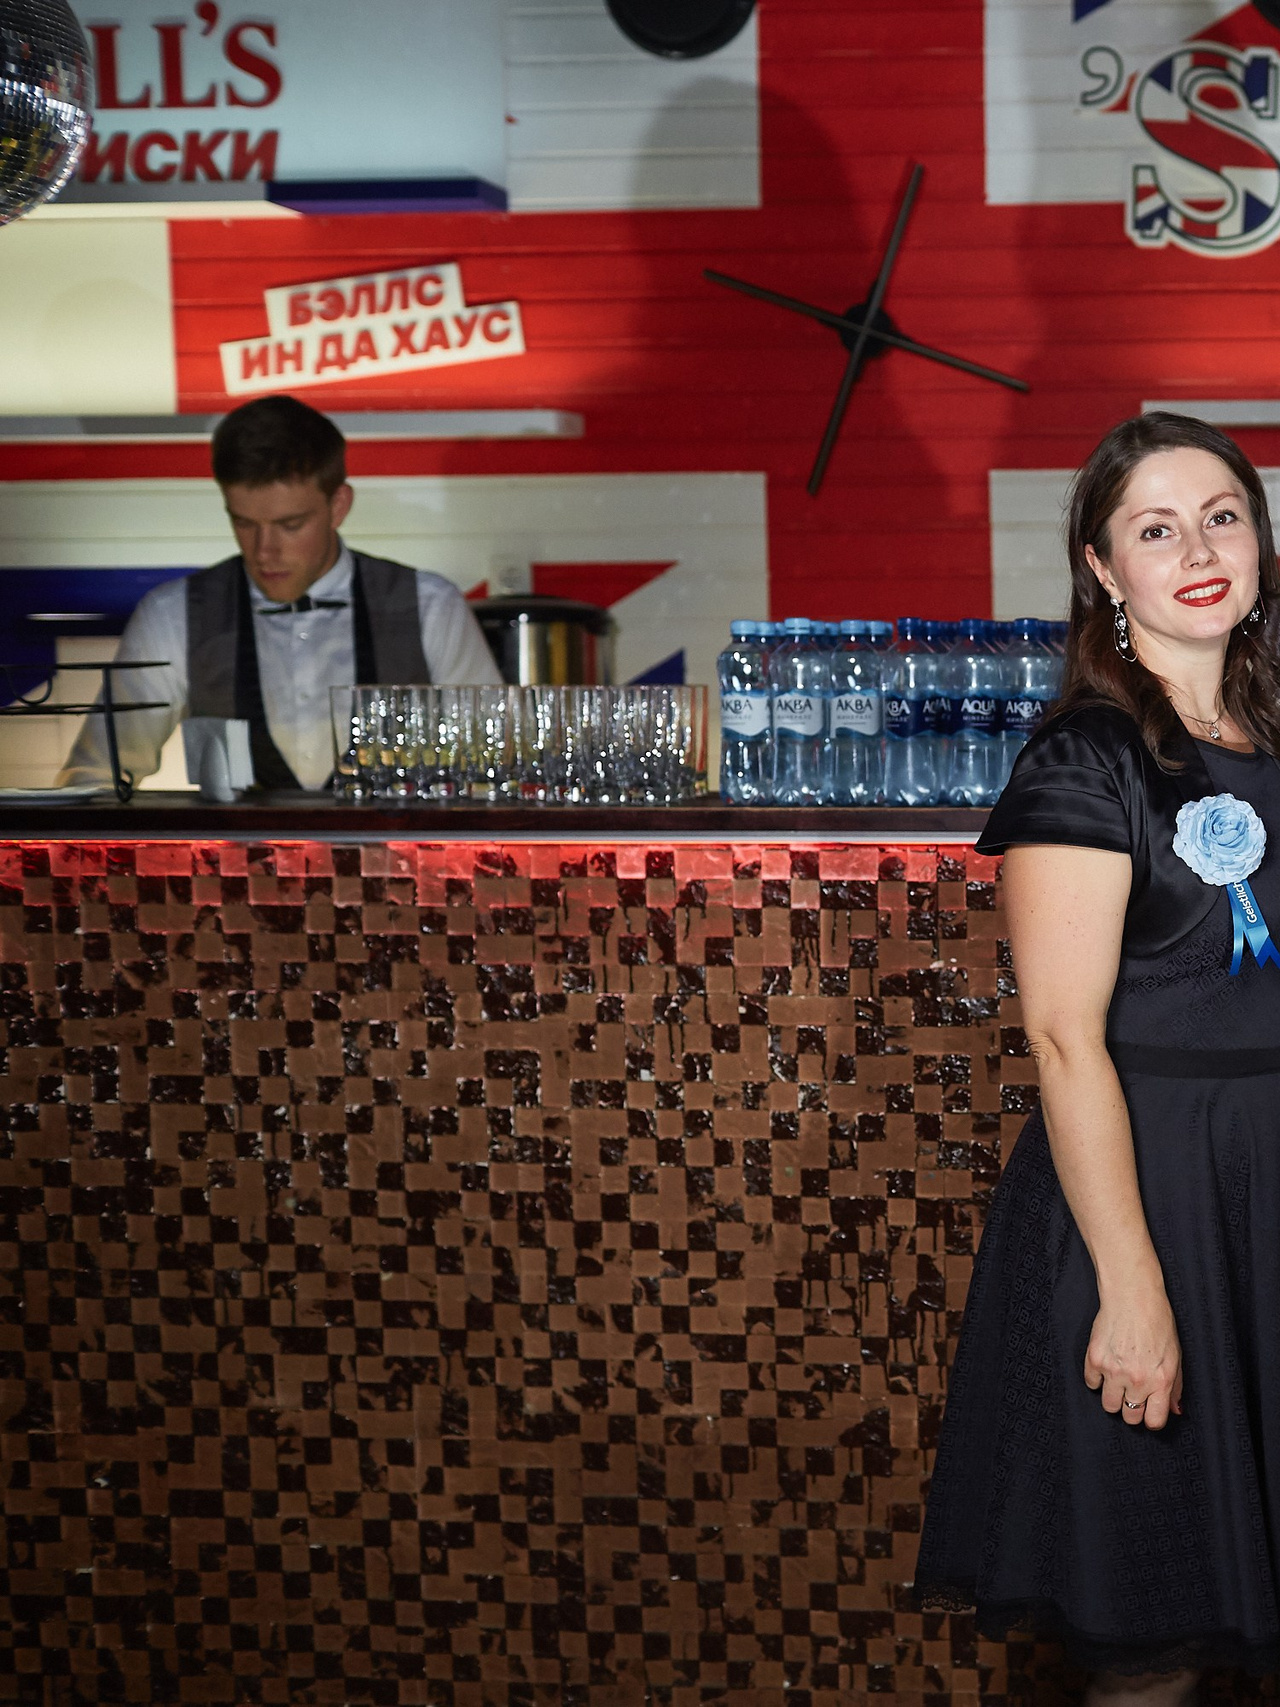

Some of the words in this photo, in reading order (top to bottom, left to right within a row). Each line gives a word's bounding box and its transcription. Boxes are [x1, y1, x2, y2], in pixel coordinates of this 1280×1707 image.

[85, 1, 283, 109] LL'S
[80, 129, 280, 183] ИСКИ
[288, 274, 445, 327] БЭЛЛС
[241, 339, 303, 380] ИН
[315, 329, 378, 375] ДА
[391, 310, 511, 358] ХАУС
[776, 698, 813, 714] АКВА
[836, 698, 873, 714] АКВА
[960, 698, 996, 716] AQUA
[1005, 700, 1043, 719] АКВА
